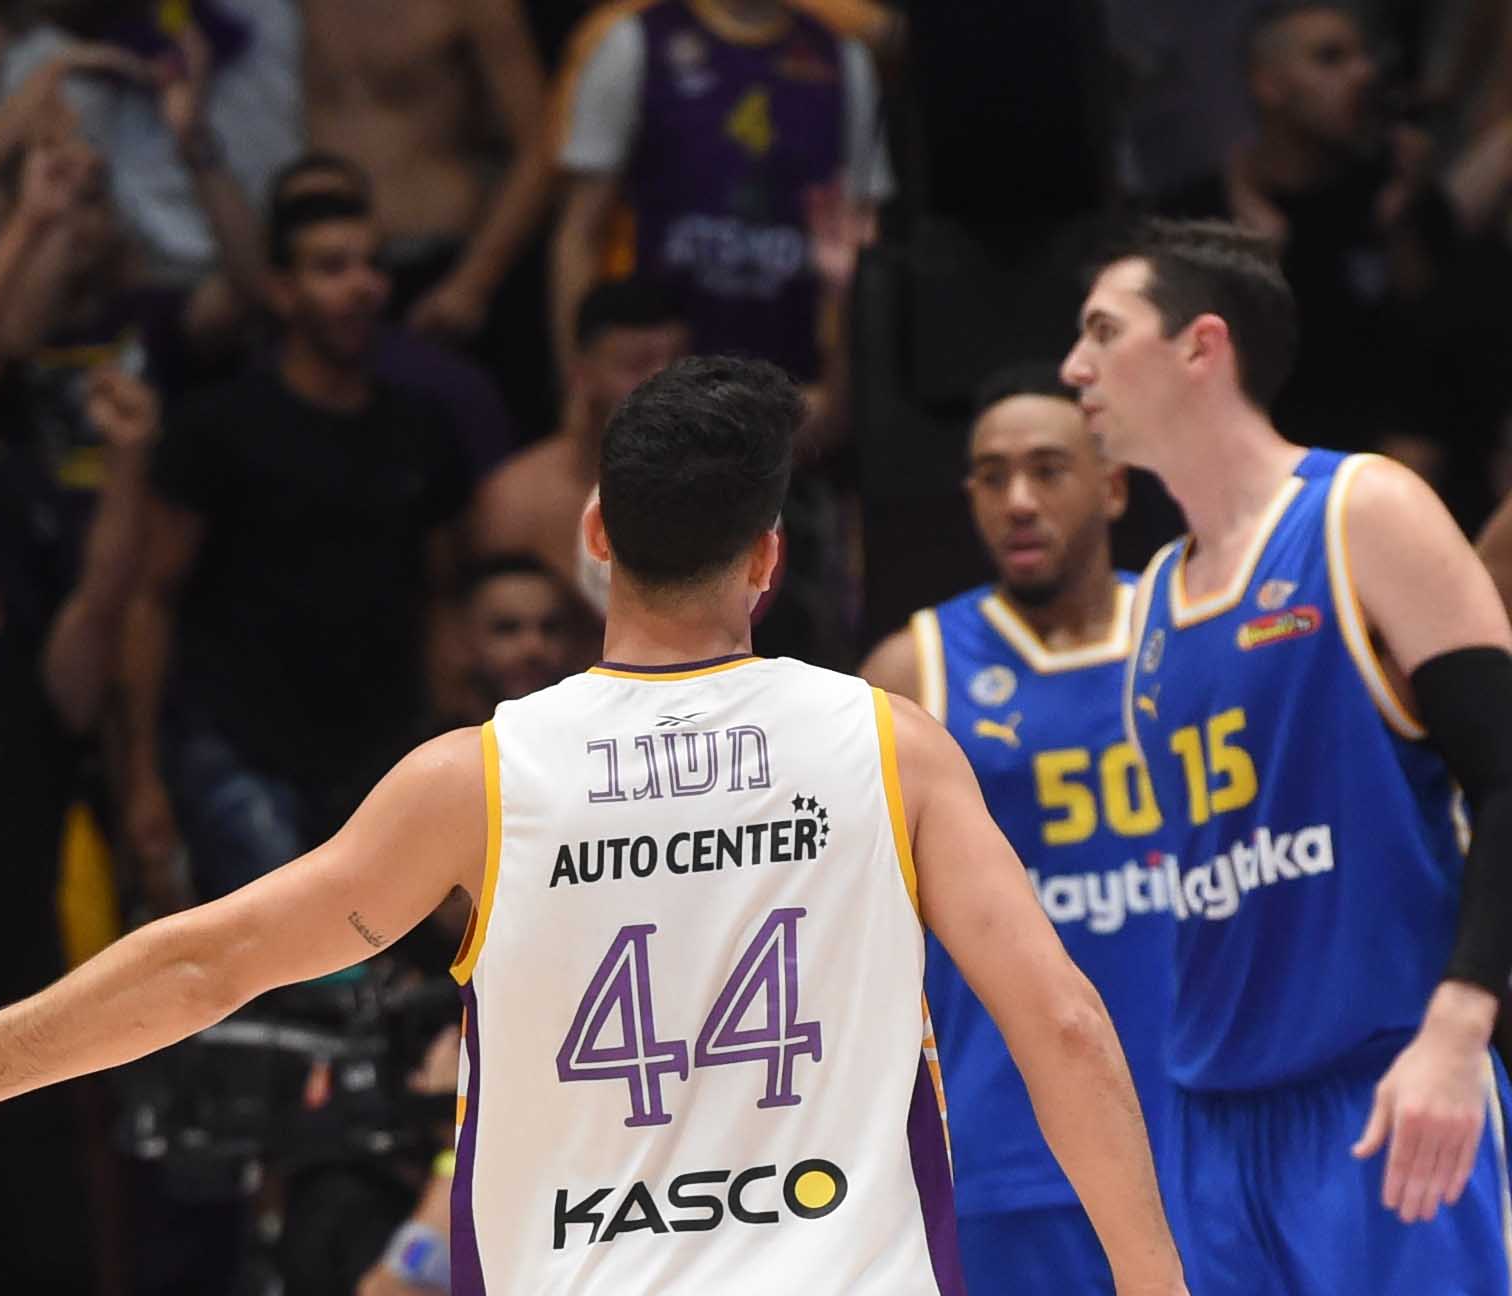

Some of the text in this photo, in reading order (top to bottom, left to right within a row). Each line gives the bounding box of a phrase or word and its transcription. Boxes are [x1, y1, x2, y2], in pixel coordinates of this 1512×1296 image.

[587, 724, 772, 803] משגב
[1033, 740, 1164, 846] 50
[1170, 707, 1259, 826] 15
[549, 817, 819, 888] AUTO CENTER
[555, 907, 823, 1128] 44
[553, 1158, 849, 1250] KASCO
